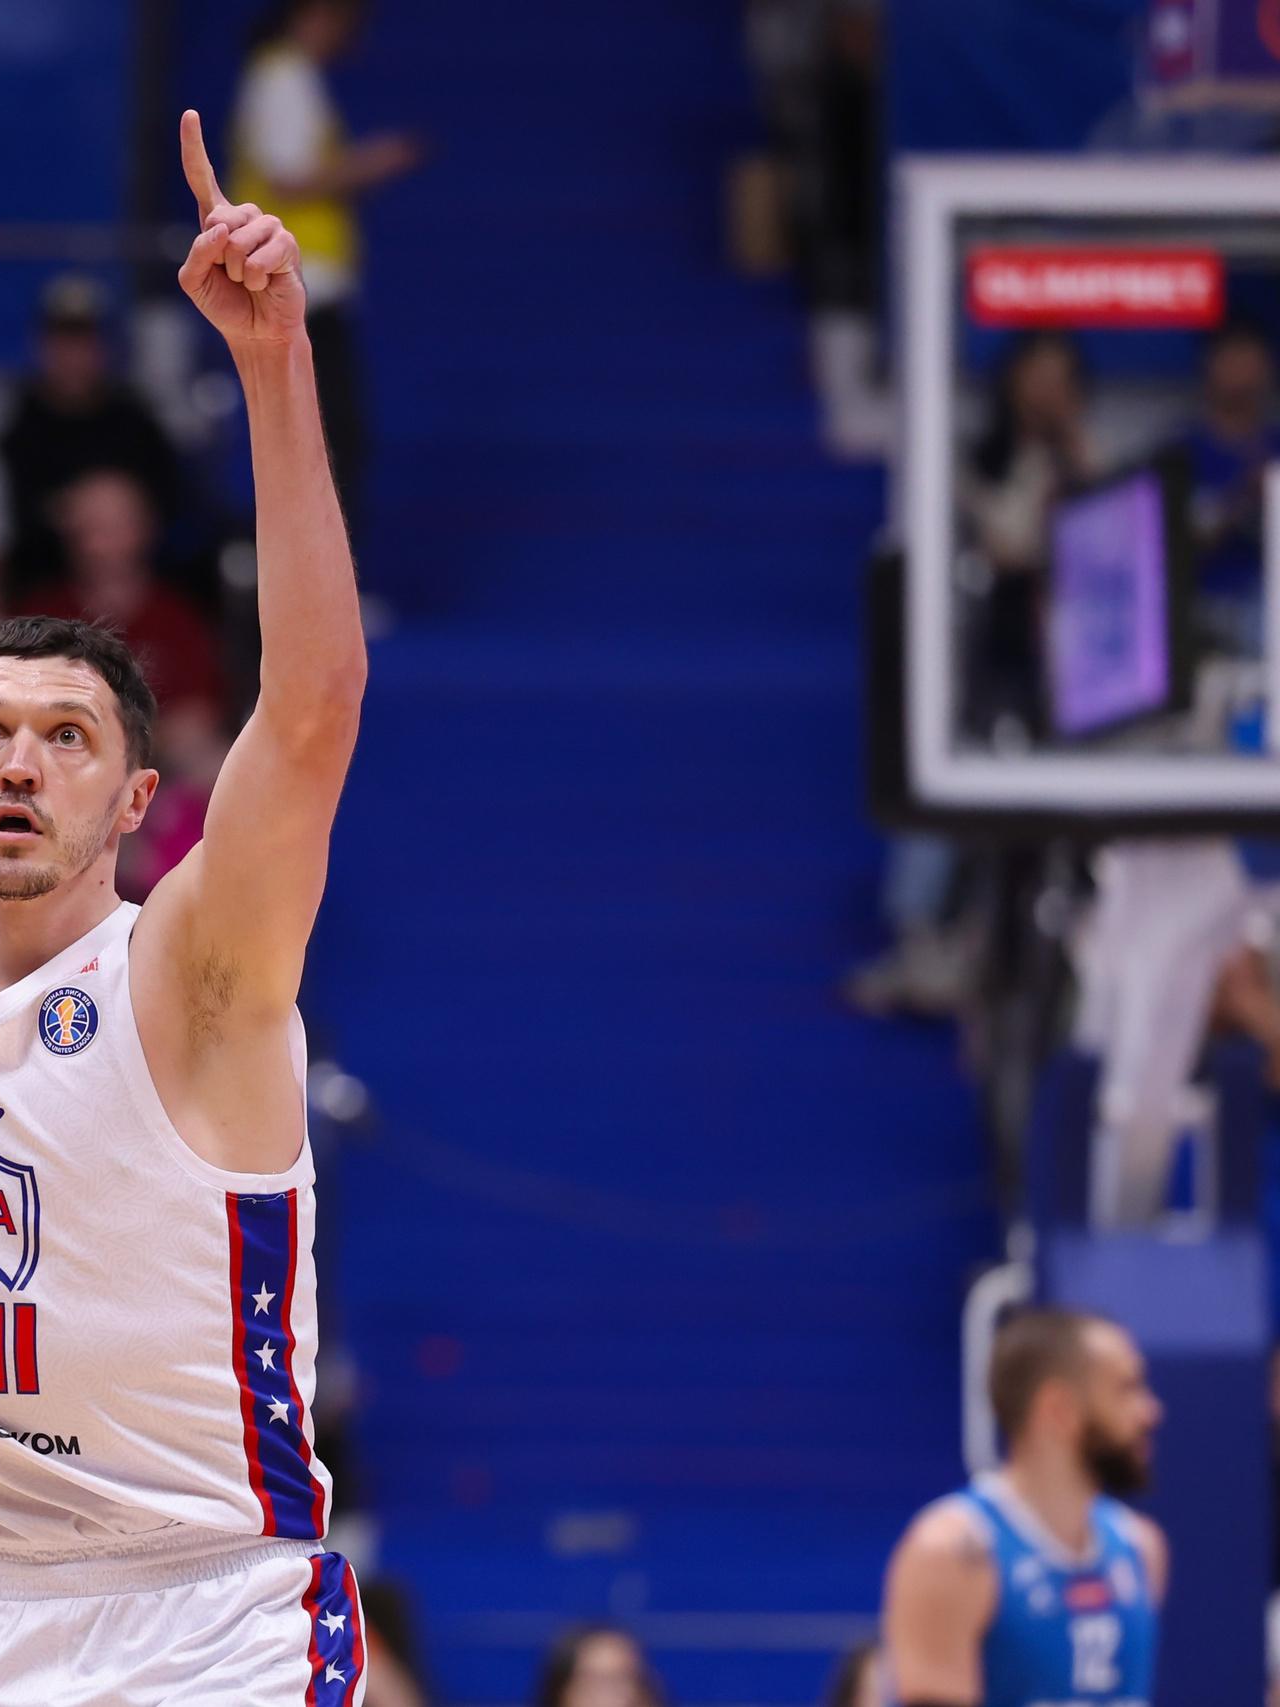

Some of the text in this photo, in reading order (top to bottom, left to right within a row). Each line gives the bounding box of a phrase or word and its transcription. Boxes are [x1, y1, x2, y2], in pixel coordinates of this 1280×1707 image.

[42, 988, 92, 1011] ЕДИНАЯ ЛИГА ВТБ
[43, 1031, 93, 1054] VTB UNITED LEAGUE
